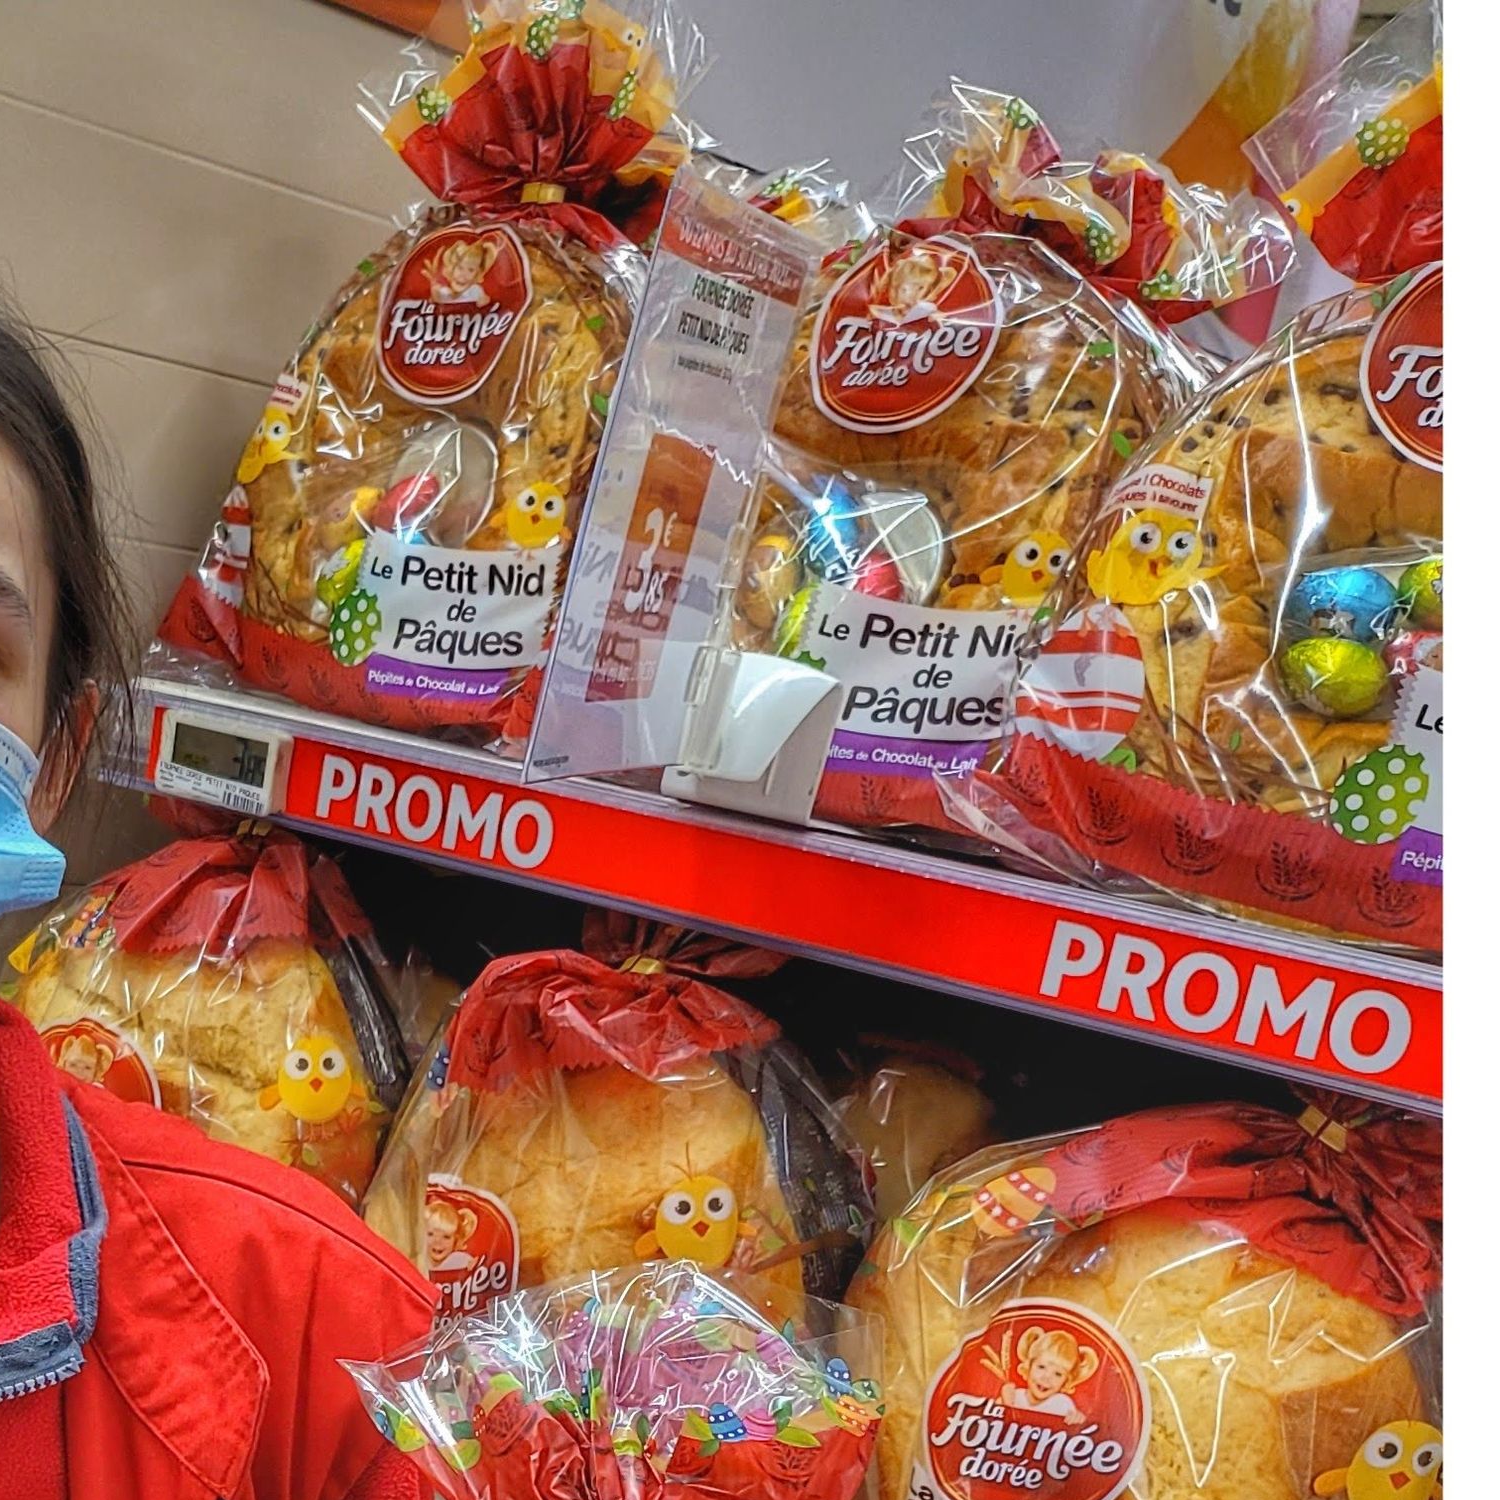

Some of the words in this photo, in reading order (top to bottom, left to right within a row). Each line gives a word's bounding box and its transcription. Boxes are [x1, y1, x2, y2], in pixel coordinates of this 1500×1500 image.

[420, 300, 435, 315] la
[384, 299, 514, 354] Fournée
[404, 340, 467, 365] dorée
[841, 360, 910, 388] dorée
[1150, 473, 1206, 499] Chocolats
[370, 556, 393, 580] Le
[400, 555, 479, 596] Petit
[488, 563, 545, 597] Nid
[446, 599, 477, 623] de
[392, 617, 524, 664] Pâques
[818, 613, 851, 641] Le
[859, 612, 960, 659] Petit
[368, 669, 405, 687] Pépites
[415, 675, 466, 695] Chocolat
[912, 663, 953, 689] de
[841, 685, 1004, 735] Pâques
[871, 749, 934, 770] Chocolat
[950, 756, 979, 770] Lait
[316, 753, 554, 869] PROMO
[1039, 919, 1412, 1075] PROMO
[983, 1398, 1006, 1419] la
[930, 1391, 1125, 1481] Fournée
[958, 1448, 1045, 1490] dorée
